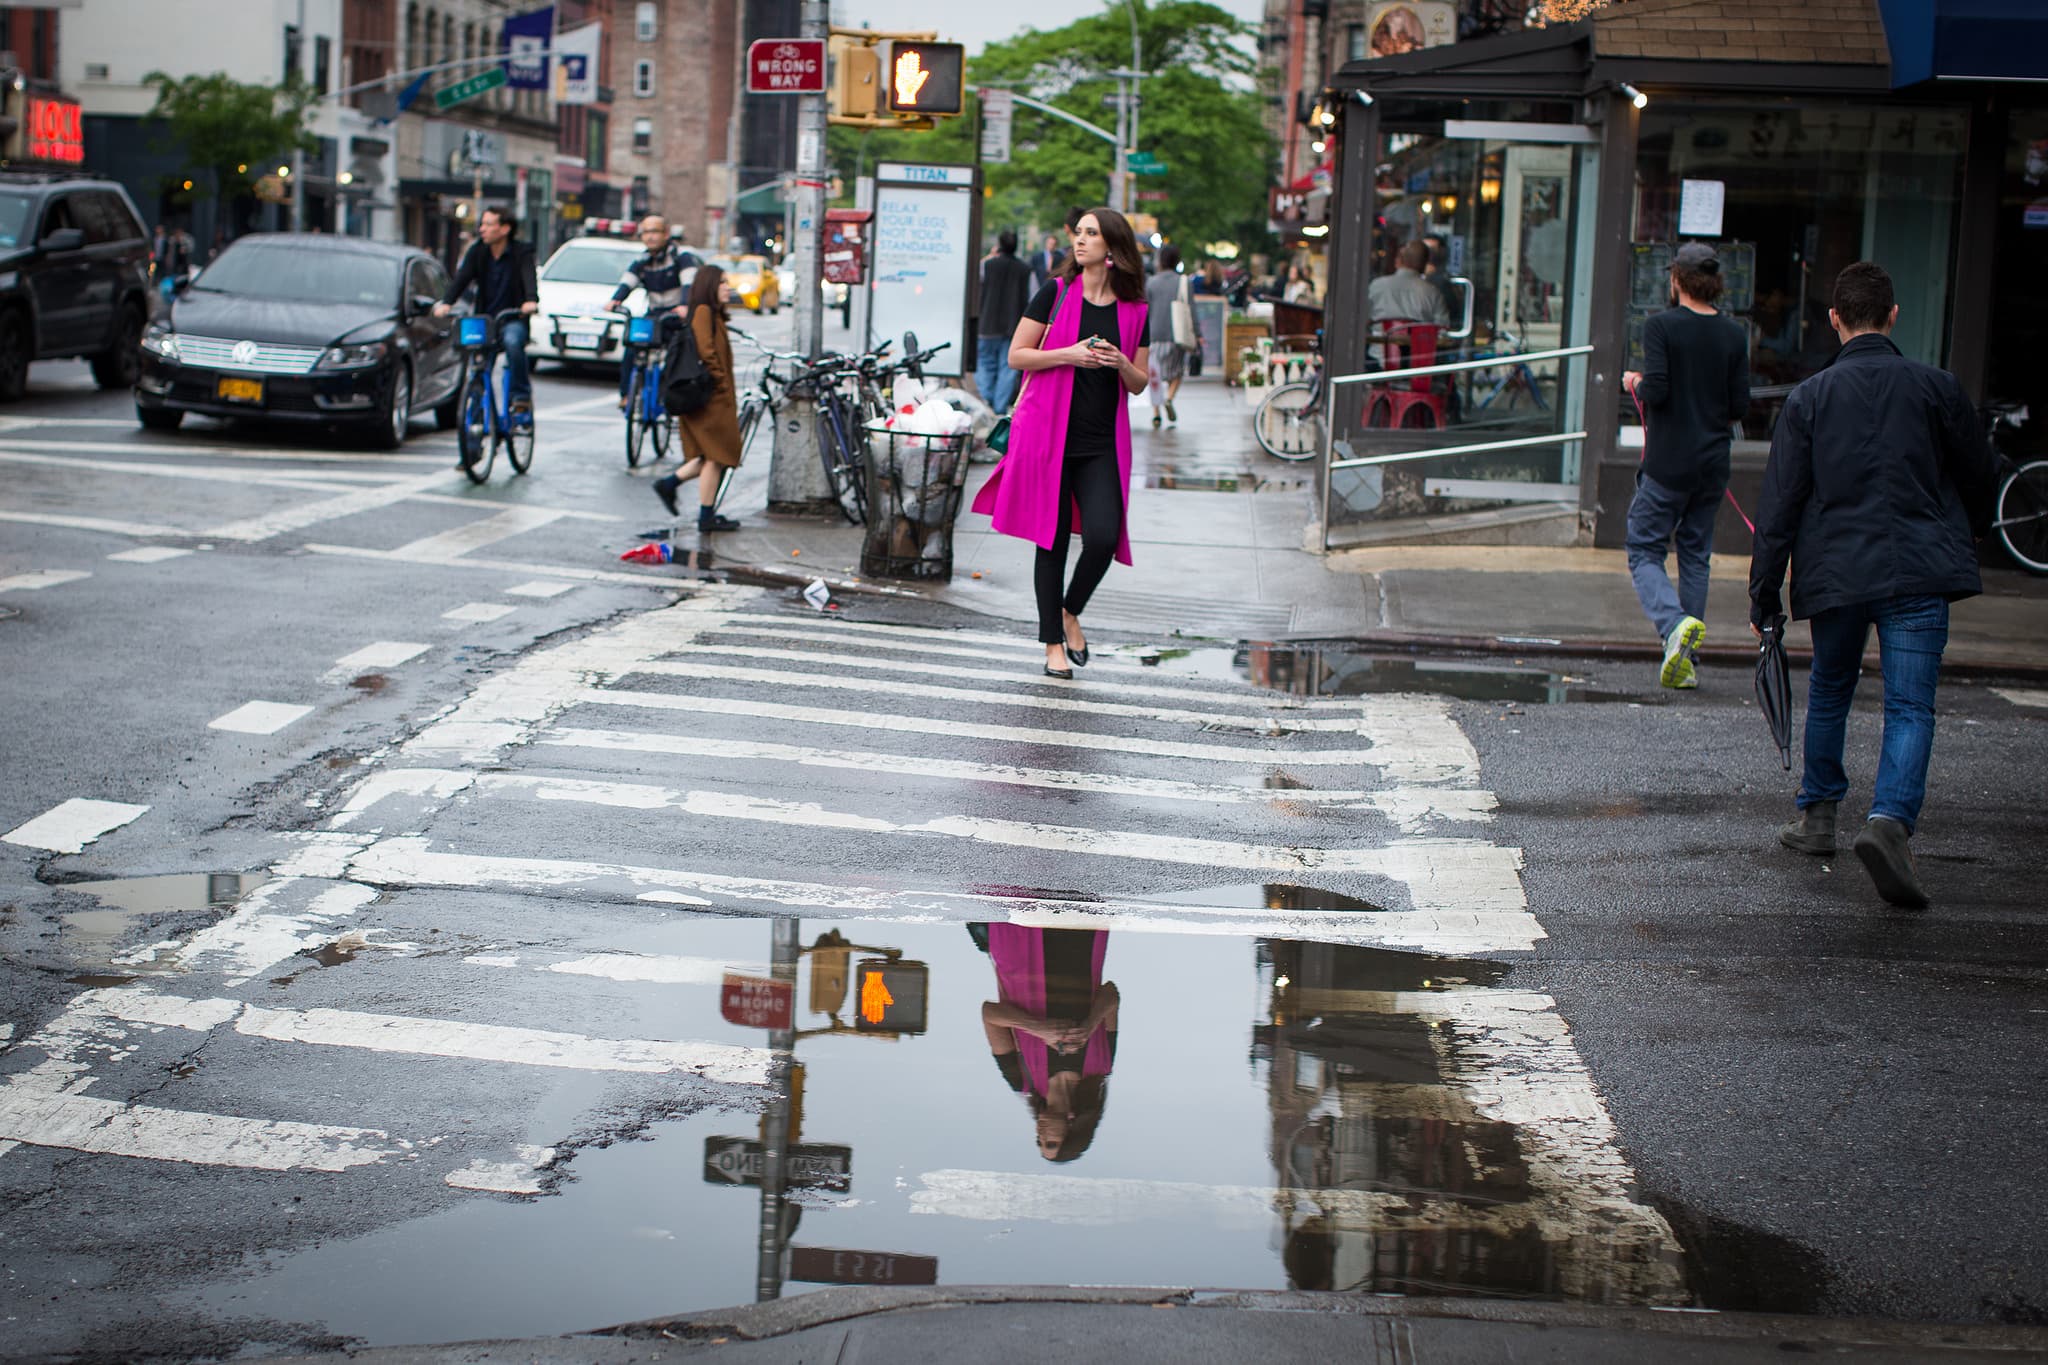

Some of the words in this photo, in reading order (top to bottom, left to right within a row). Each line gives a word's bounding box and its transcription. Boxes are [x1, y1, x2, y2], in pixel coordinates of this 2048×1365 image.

[757, 59, 816, 73] WRONG
[769, 74, 803, 88] WAY
[904, 167, 948, 180] TITAN
[881, 201, 918, 213] RELAX
[882, 214, 914, 225] YOUR
[880, 227, 907, 237] NOT
[910, 229, 944, 240] YOUR
